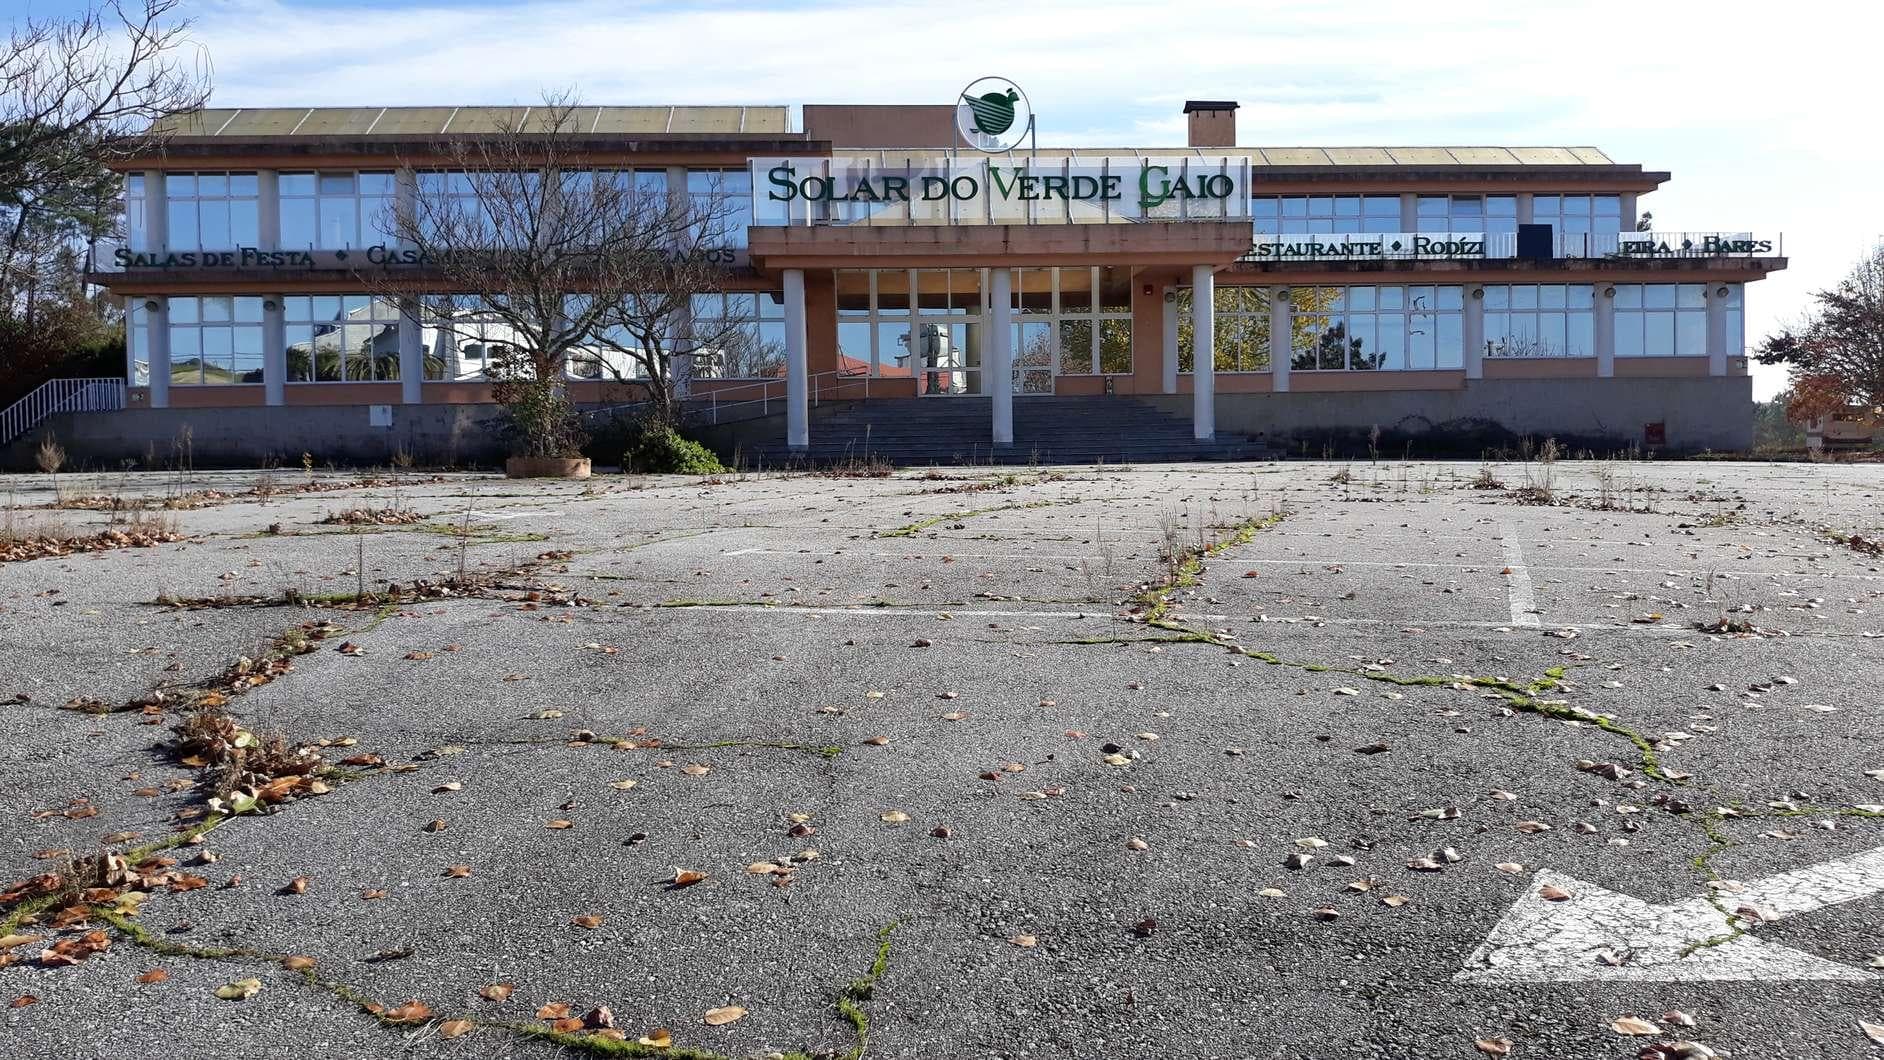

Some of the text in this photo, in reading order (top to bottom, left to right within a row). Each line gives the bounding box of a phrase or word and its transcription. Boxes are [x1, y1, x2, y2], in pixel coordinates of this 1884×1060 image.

[768, 165, 1234, 208] SOLAR DO VERDE GAIO
[115, 249, 196, 267] SALAS
[202, 252, 234, 266] DE
[240, 248, 315, 267] FESTA
[1246, 243, 1381, 258] ESTAURANTE
[1703, 236, 1772, 253] BARES
